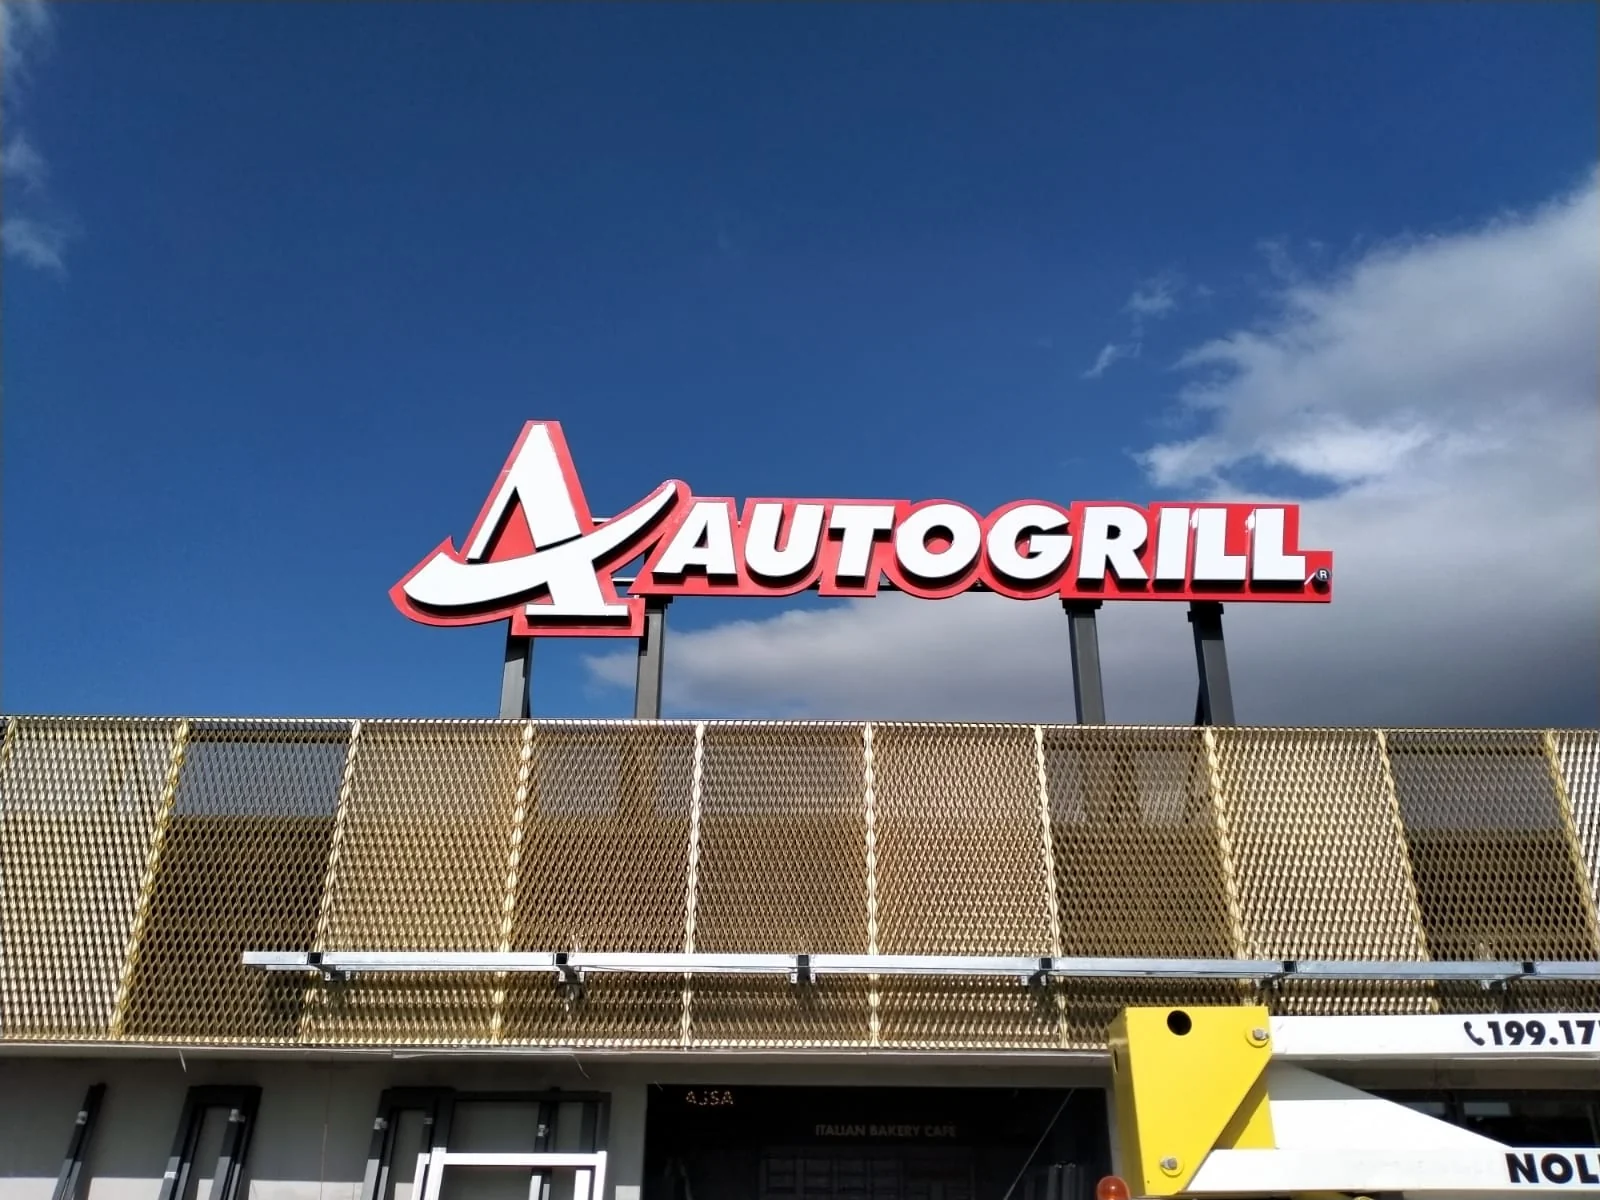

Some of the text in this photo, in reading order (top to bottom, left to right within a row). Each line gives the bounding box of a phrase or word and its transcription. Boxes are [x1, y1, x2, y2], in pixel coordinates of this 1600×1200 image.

[652, 502, 1306, 581] AUTOGRILL
[1487, 1019, 1600, 1046] 199.17
[815, 1123, 866, 1136] ITALIAN
[869, 1124, 920, 1137] BAKERY
[1504, 1152, 1600, 1185] NOL
